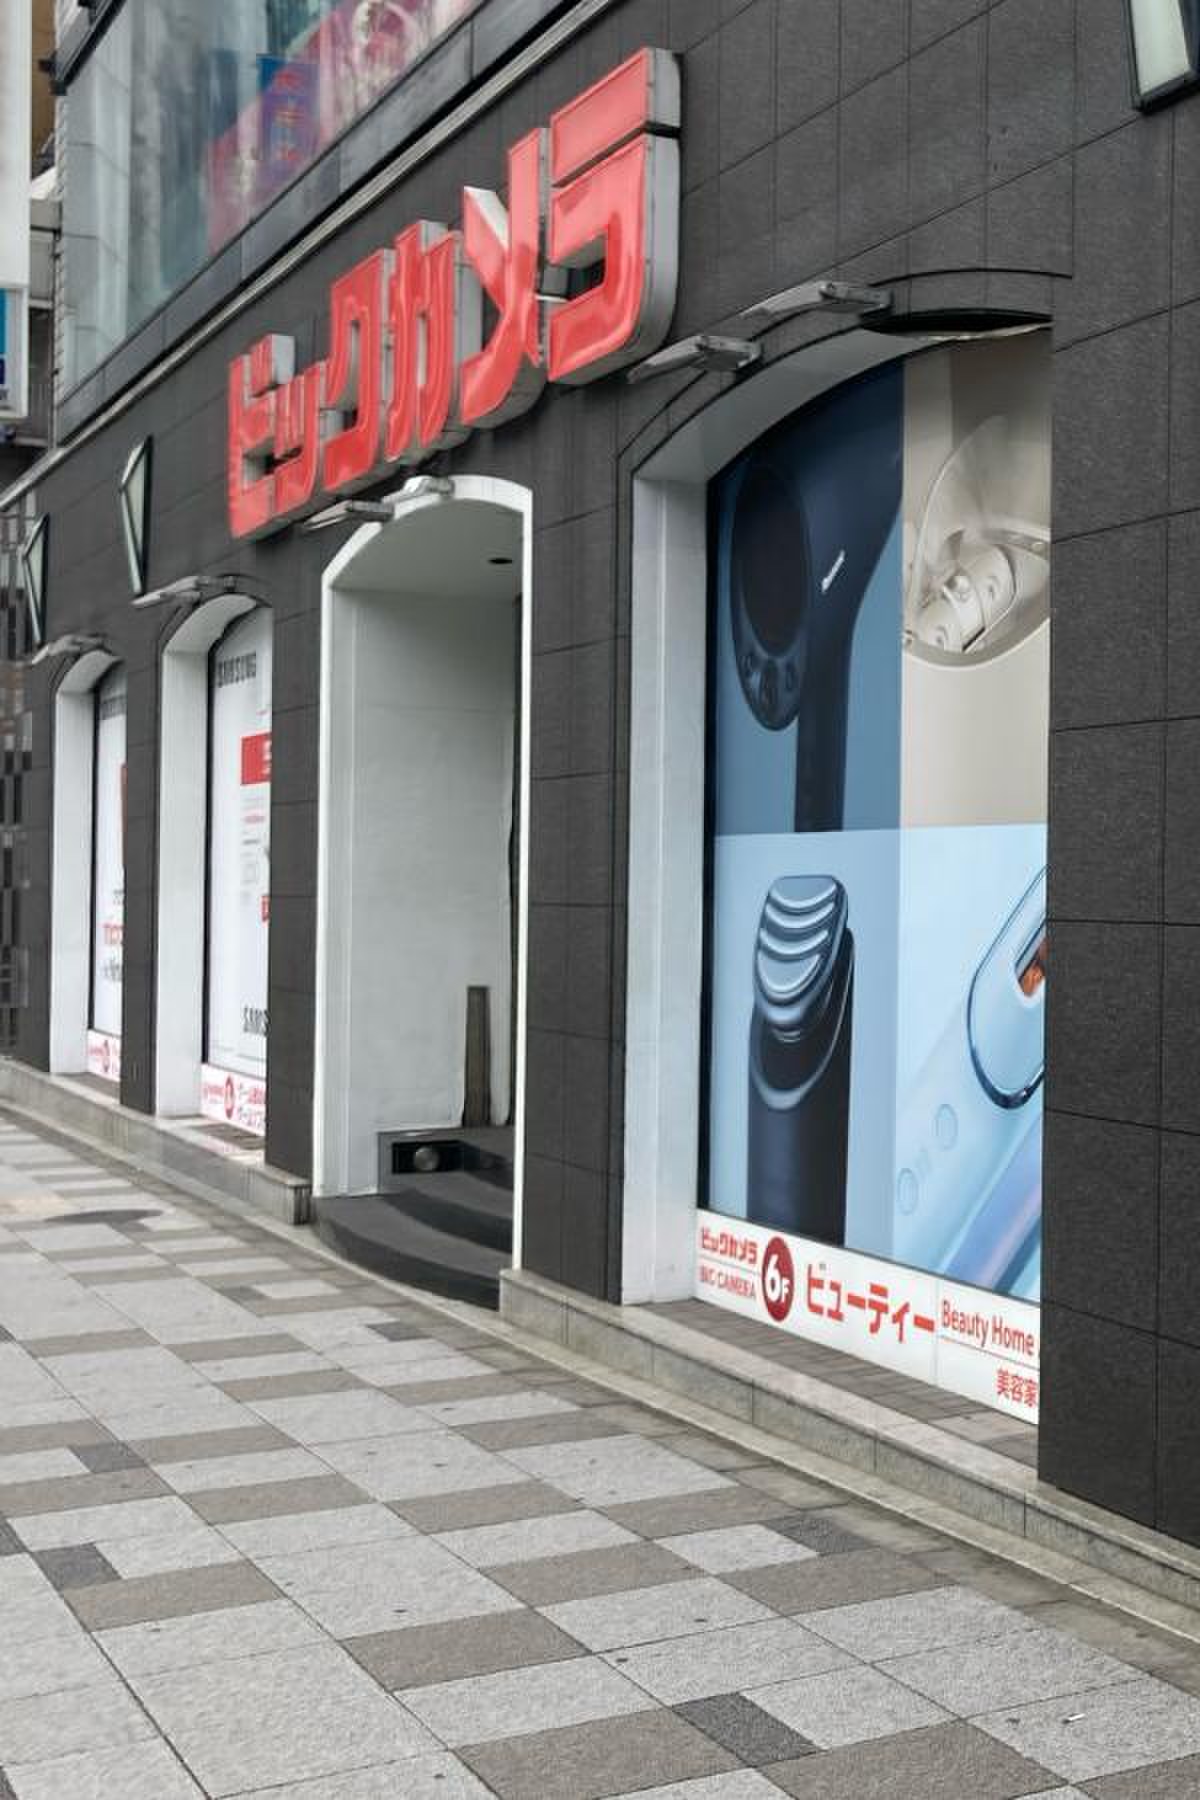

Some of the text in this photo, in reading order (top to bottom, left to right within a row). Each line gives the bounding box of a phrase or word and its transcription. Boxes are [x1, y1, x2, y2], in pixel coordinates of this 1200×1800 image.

[228, 47, 681, 540] ビックカメラ
[701, 1226, 758, 1265] ビックカメラ
[766, 1252, 790, 1303] 6F
[806, 1263, 936, 1343] ビューティー
[942, 1299, 1035, 1357] Beauty Home
